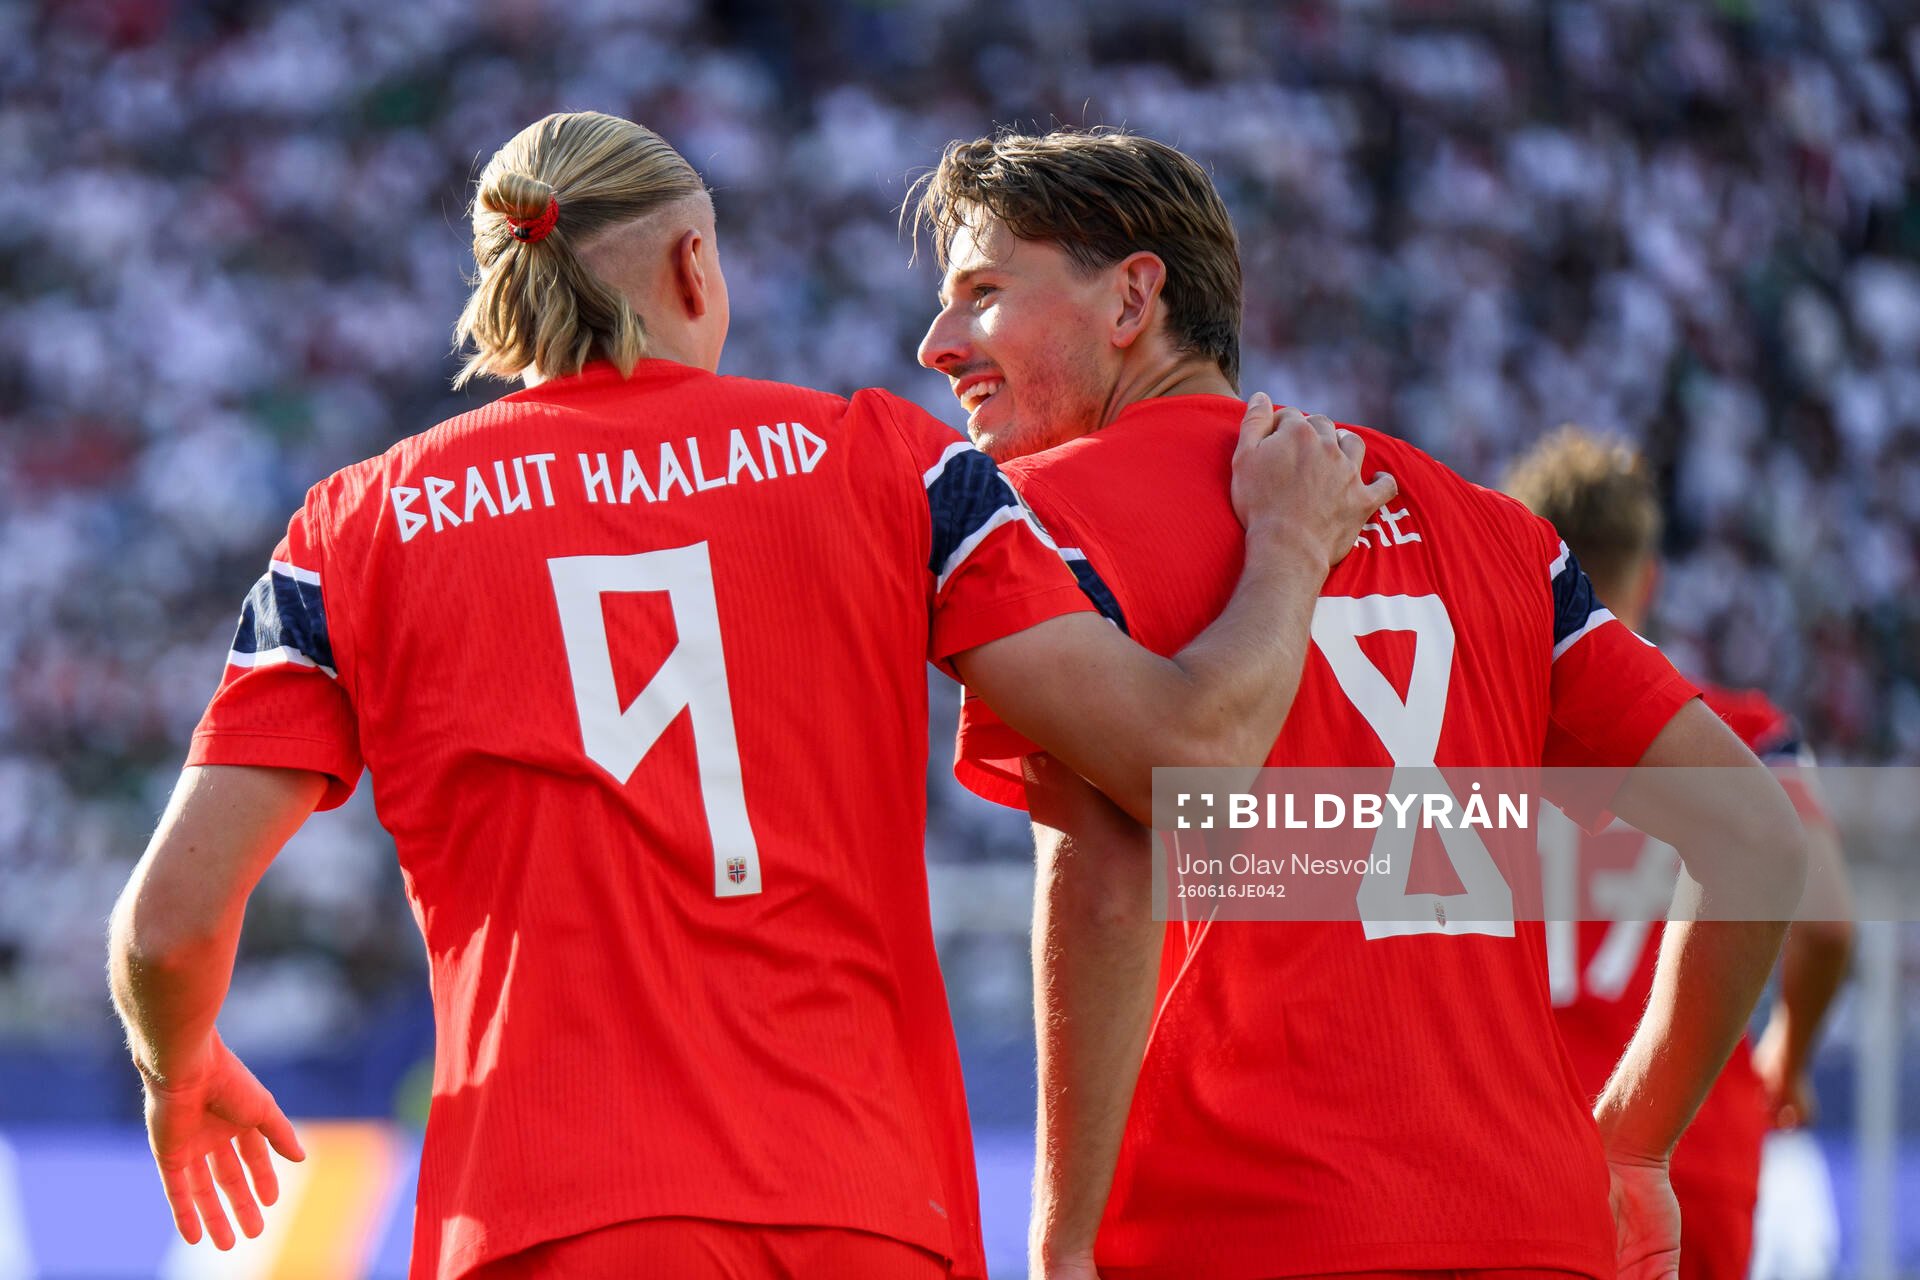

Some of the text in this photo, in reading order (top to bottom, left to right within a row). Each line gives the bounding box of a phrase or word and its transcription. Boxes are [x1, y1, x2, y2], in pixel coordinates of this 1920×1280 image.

[391, 422, 828, 543] BRAUT HAALAND
[546, 540, 763, 898] 9
[1310, 593, 1516, 941] 8
